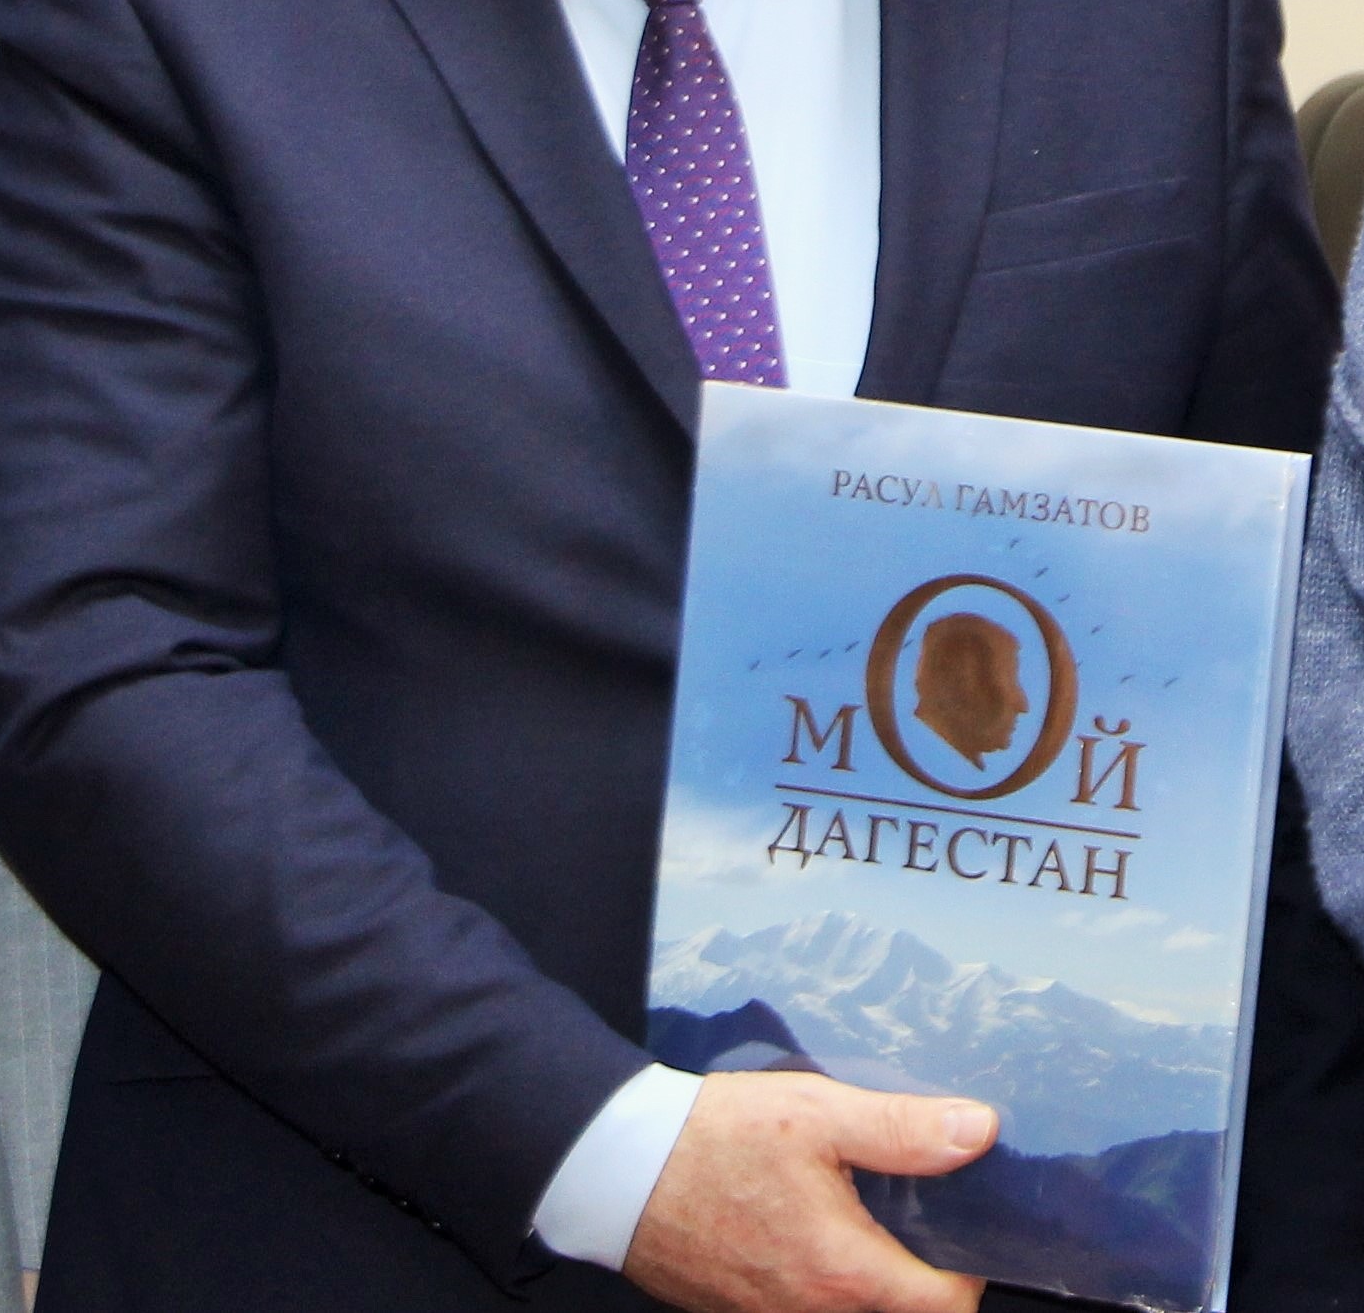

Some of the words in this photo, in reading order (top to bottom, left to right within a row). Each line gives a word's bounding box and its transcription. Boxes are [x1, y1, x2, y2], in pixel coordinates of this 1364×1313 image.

[830, 469, 945, 510] РАСУЛ
[954, 483, 1151, 534] ГАМЗАТОВ
[781, 572, 1147, 811] МОЙ
[767, 801, 1134, 900] ДАГЕСТАН
